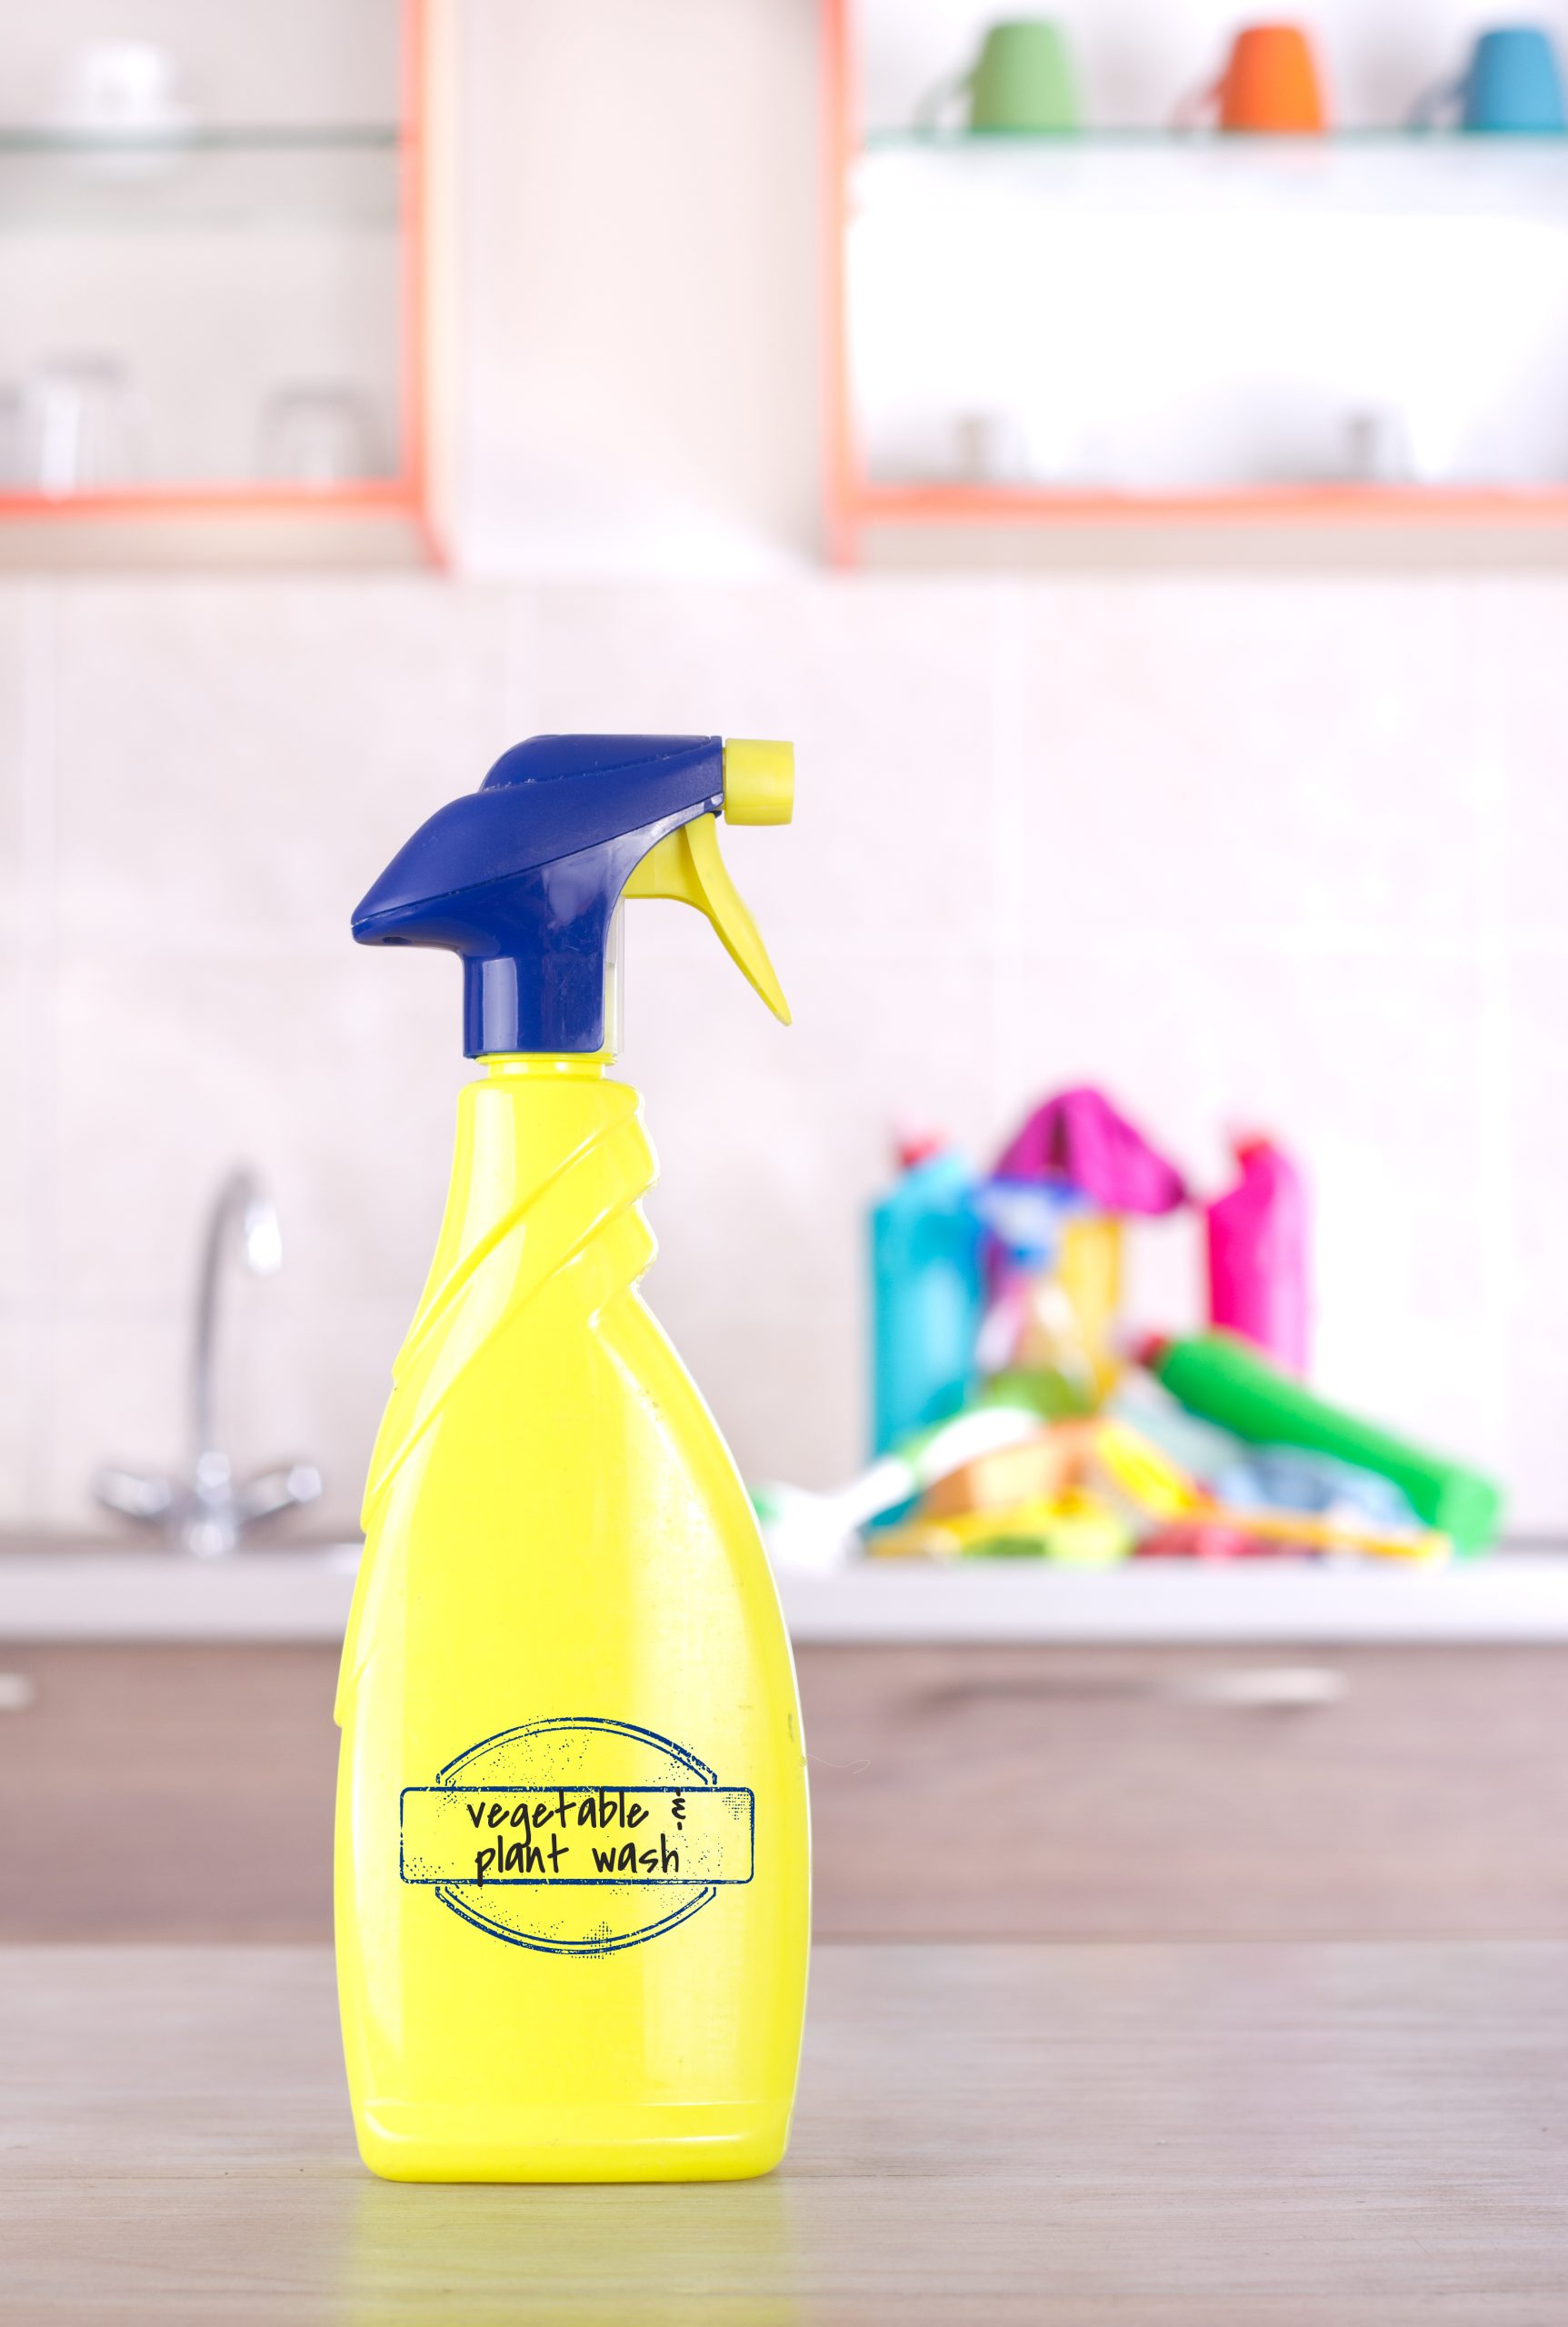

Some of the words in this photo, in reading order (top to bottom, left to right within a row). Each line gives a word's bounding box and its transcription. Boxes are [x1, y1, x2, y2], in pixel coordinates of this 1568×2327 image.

[467, 1789, 649, 1847] vegetable
[474, 1834, 570, 1887] plant
[592, 1833, 679, 1873] wash
